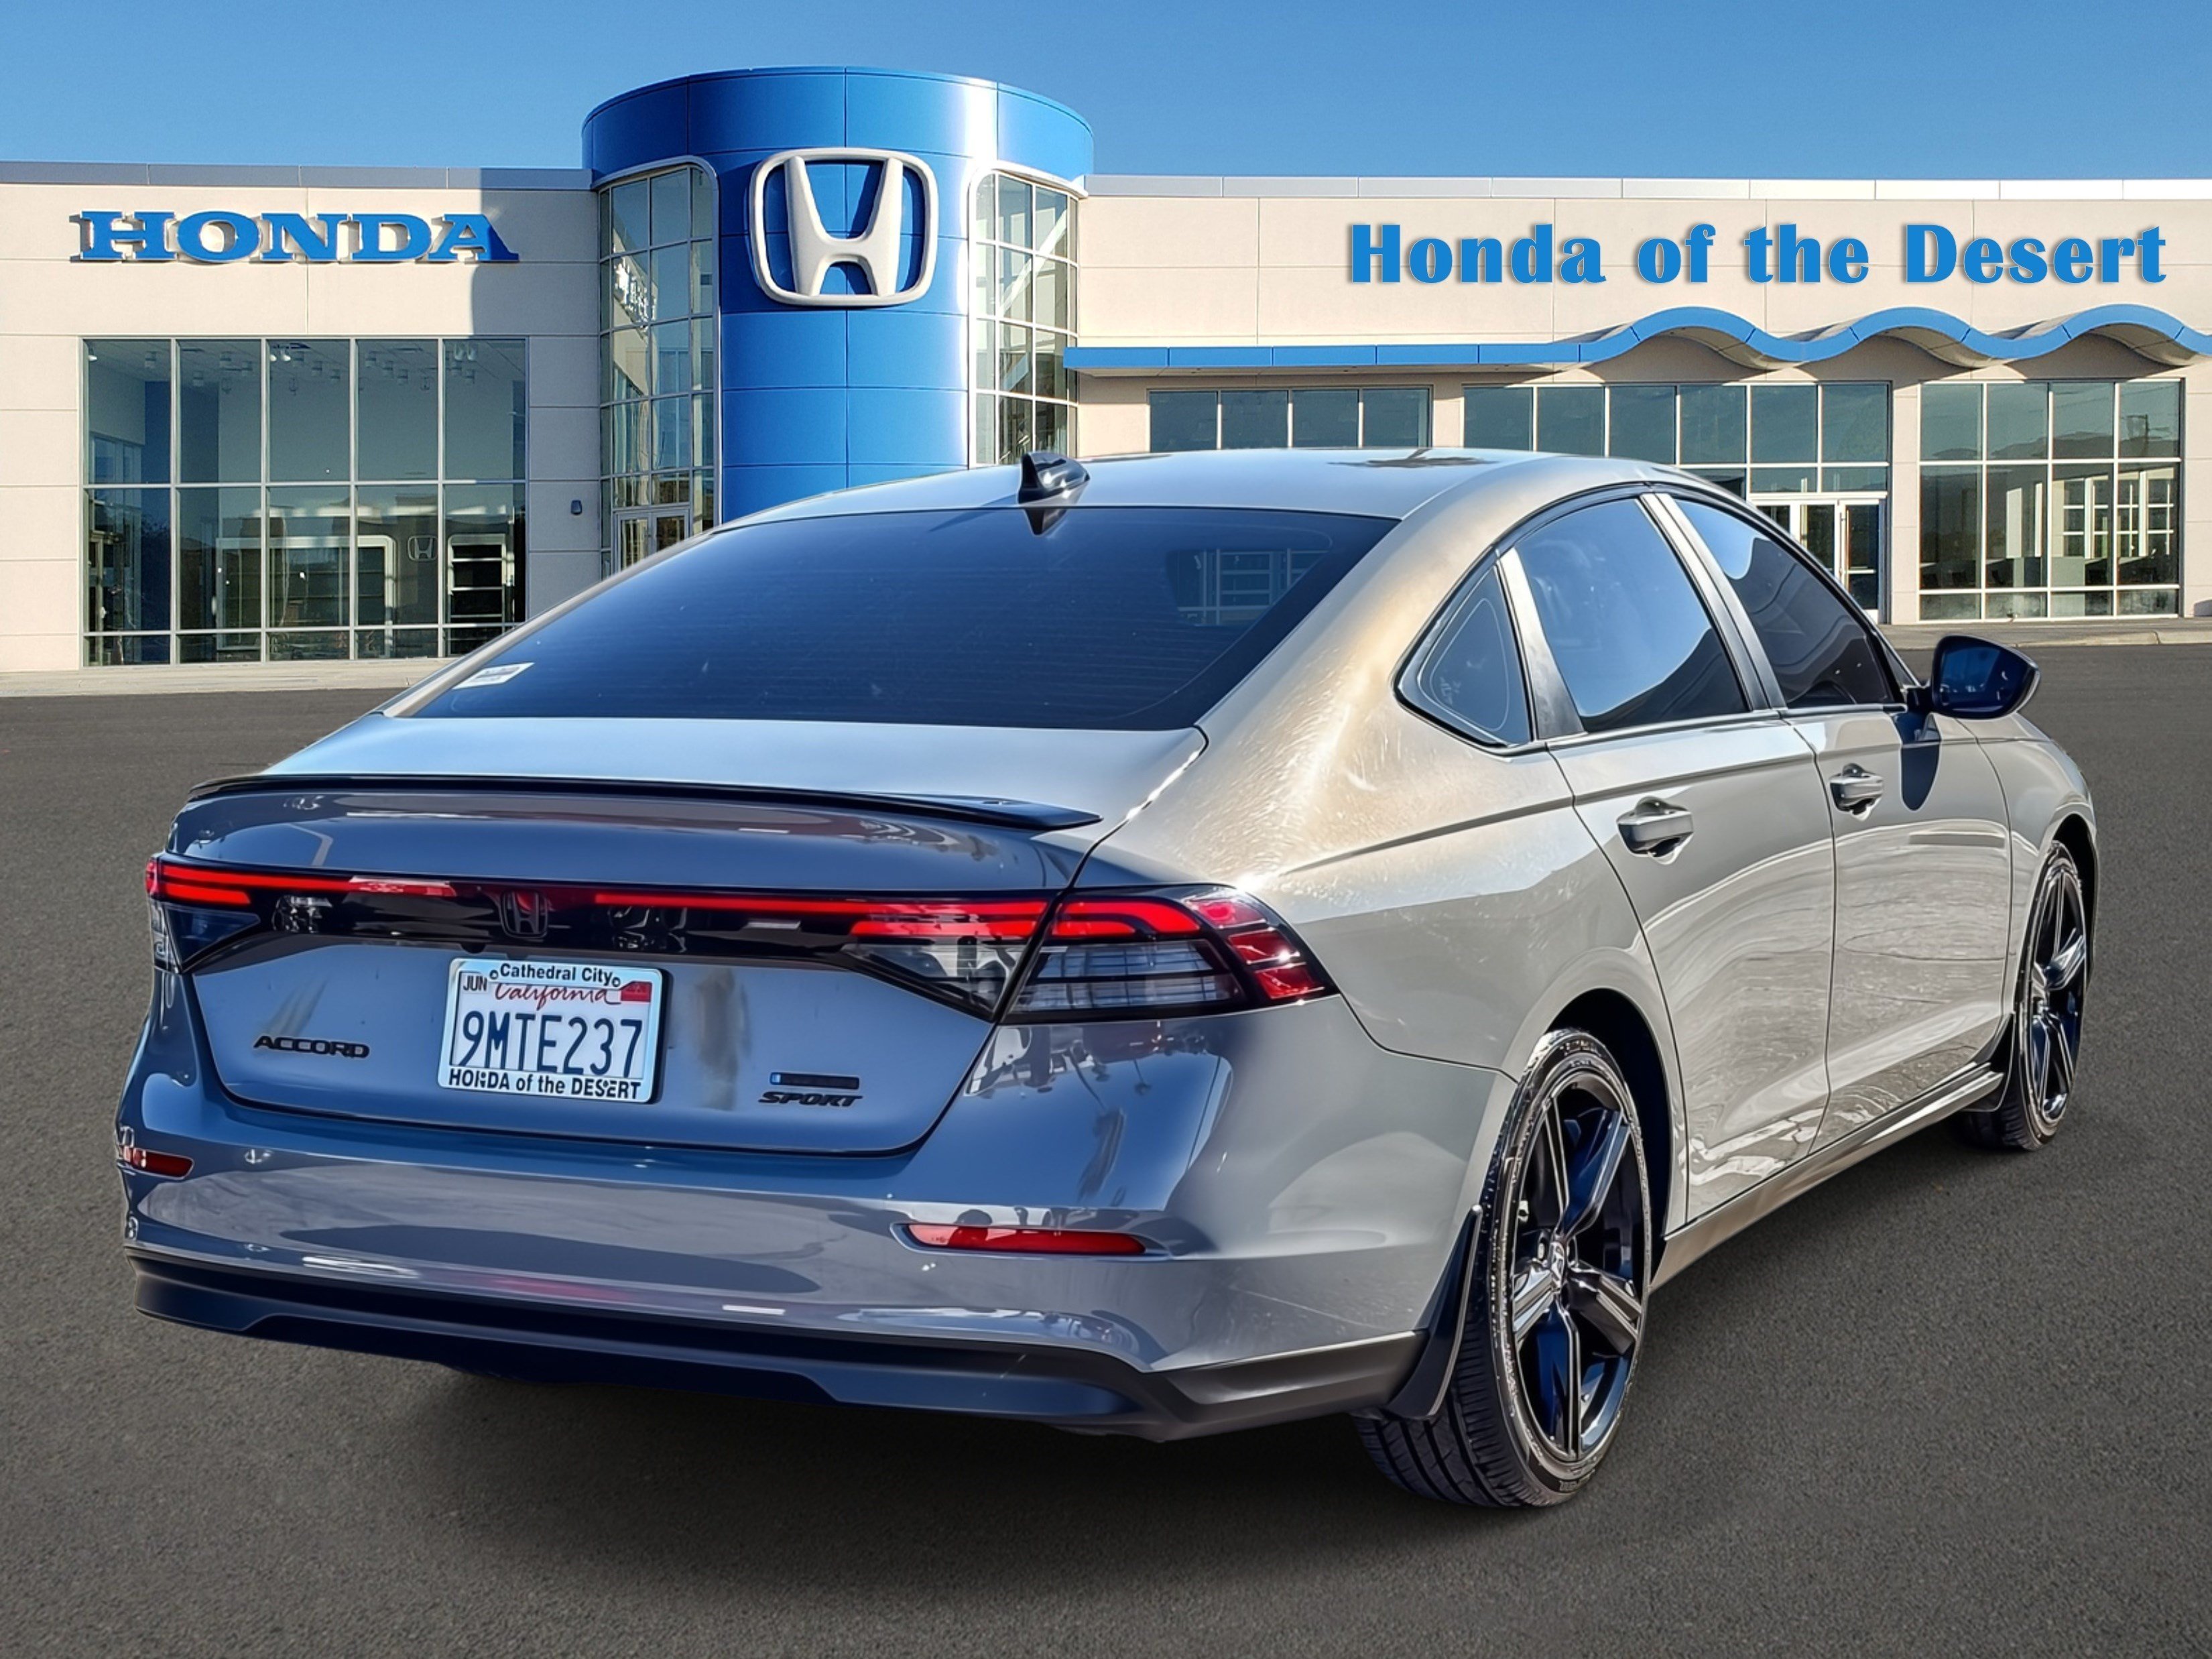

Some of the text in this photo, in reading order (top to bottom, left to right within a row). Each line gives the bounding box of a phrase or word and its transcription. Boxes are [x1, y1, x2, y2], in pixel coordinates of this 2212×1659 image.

[81, 210, 519, 262] HONDA
[1351, 223, 2167, 284] Honda of the Desert
[463, 976, 487, 991] JUN
[500, 963, 613, 986] Cathedral City
[253, 1036, 370, 1058] ACCORD
[458, 1011, 643, 1078] 9MTE237
[448, 1068, 641, 1099] HONDA of the DESERT
[758, 1091, 863, 1107] SPORT
